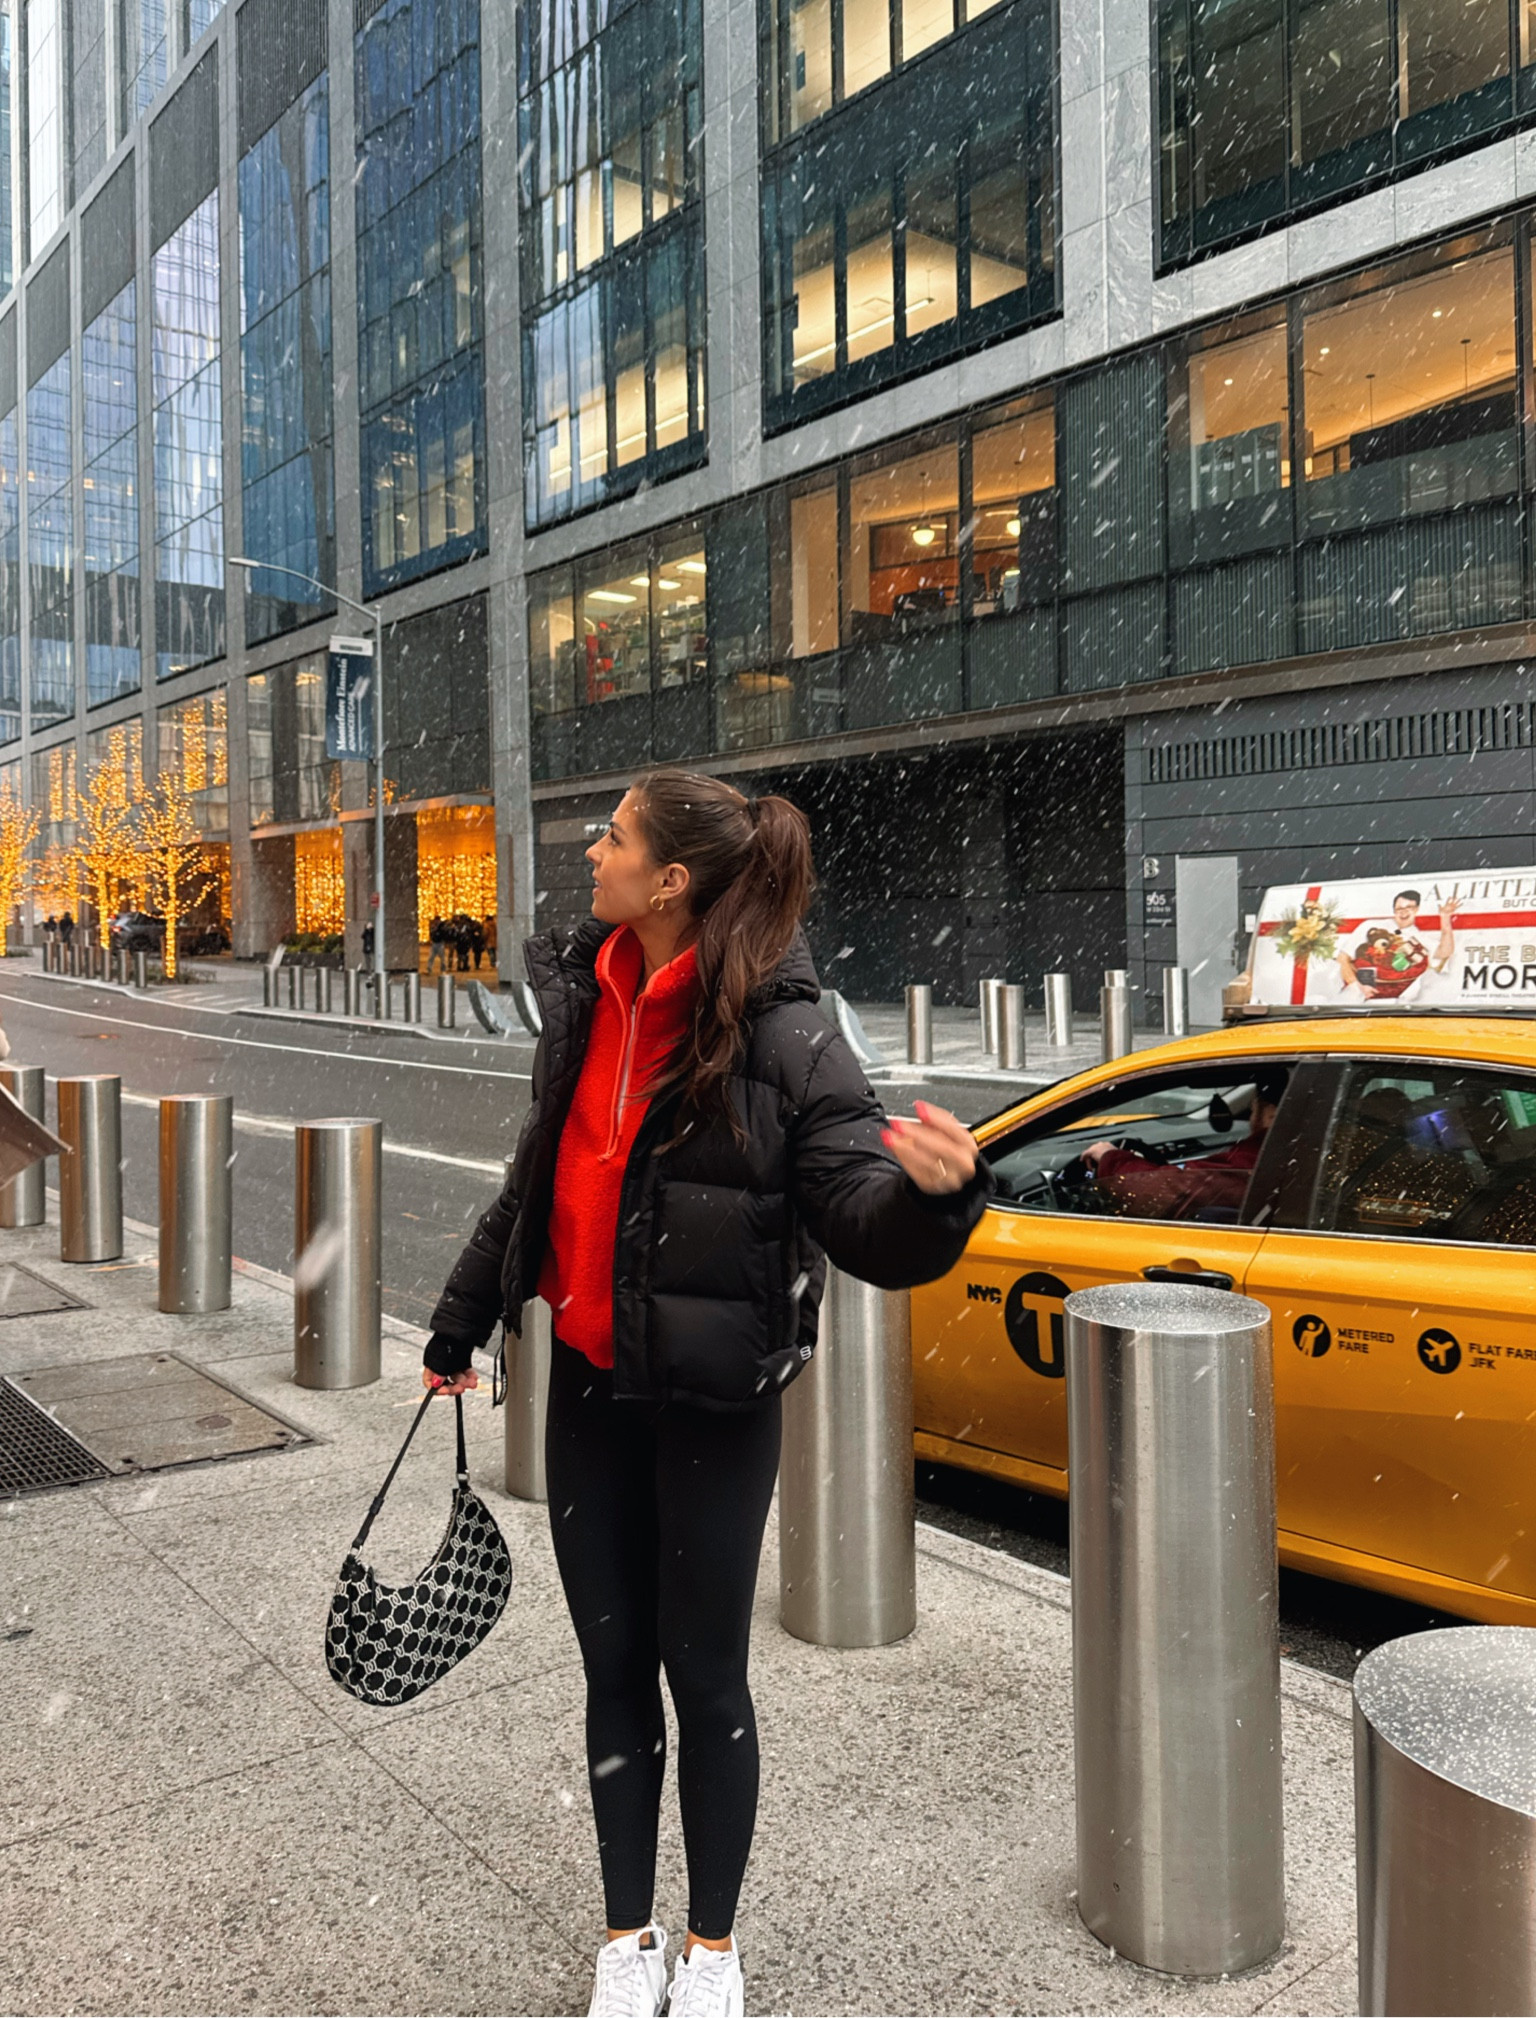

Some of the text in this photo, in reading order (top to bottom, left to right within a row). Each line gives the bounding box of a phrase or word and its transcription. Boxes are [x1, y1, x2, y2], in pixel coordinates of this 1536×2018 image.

[1143, 857, 1160, 879] B
[1424, 877, 1536, 901] A LITTL
[1503, 898, 1528, 908] BUT
[1464, 945, 1511, 964] THE
[967, 1283, 1002, 1304] NYC
[1337, 1327, 1395, 1344] METERED
[1338, 1341, 1369, 1354] FARE
[1468, 1343, 1536, 1361] FLAT FAR
[1468, 1357, 1496, 1370] JFK
